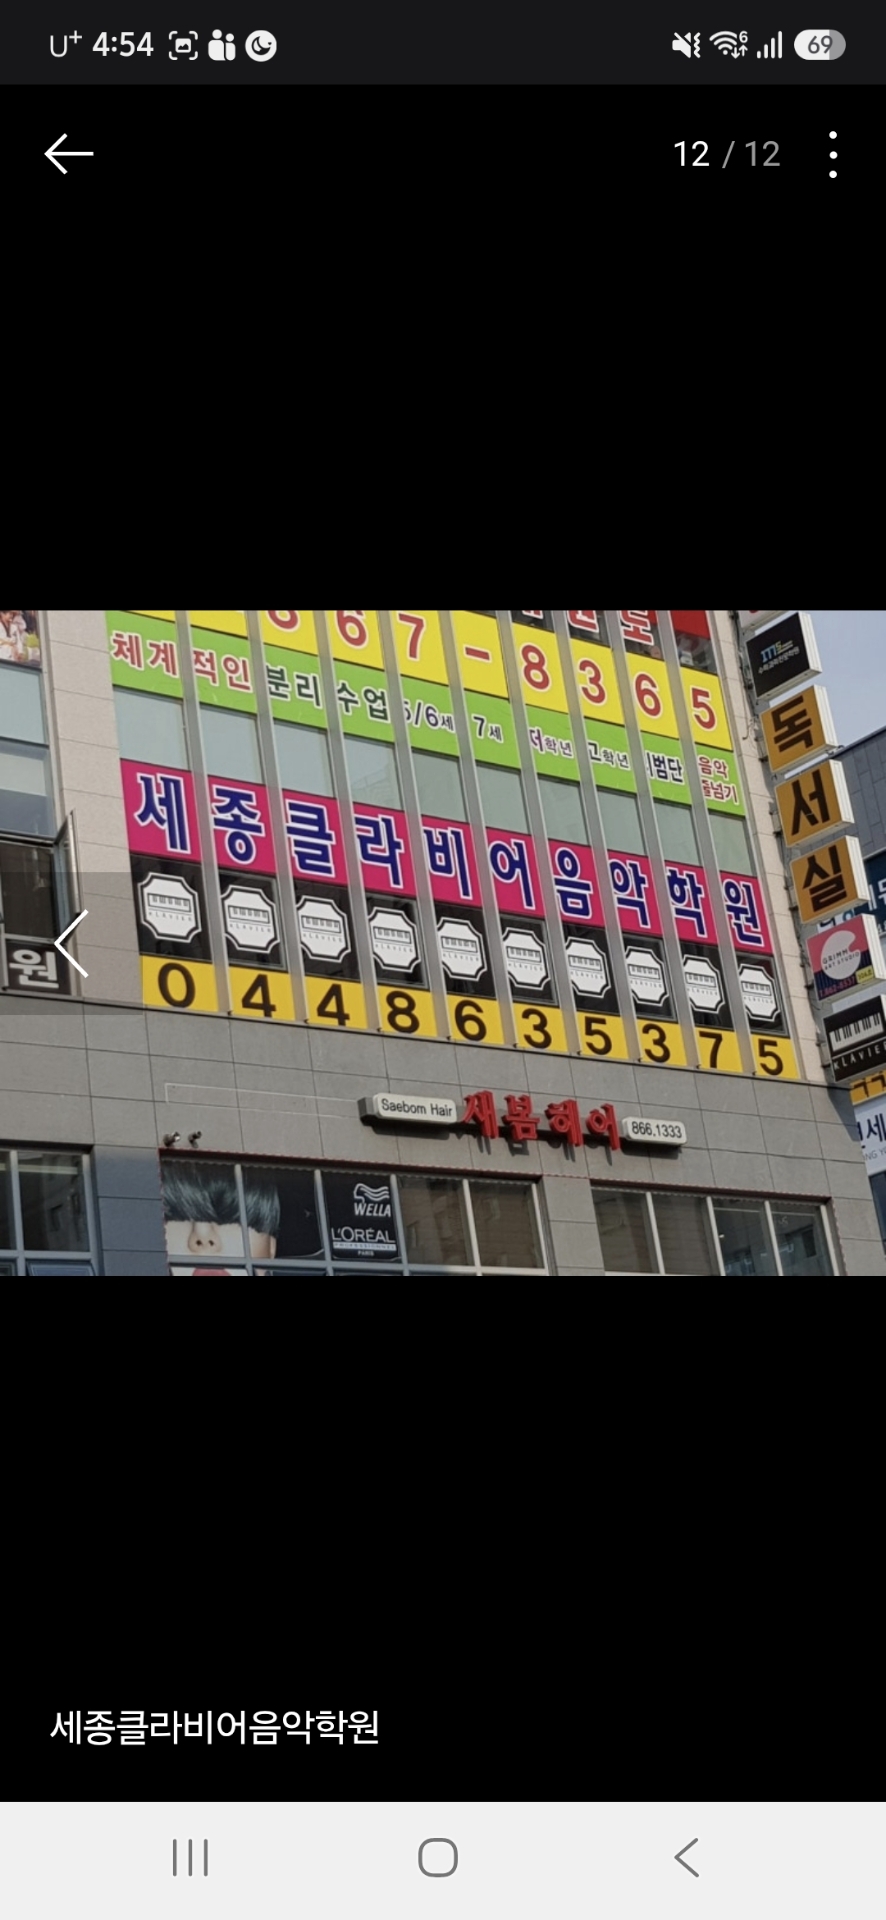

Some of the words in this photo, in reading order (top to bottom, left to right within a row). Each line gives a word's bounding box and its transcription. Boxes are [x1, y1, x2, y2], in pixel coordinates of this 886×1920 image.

[645, 752, 684, 783] 범단
[698, 755, 728, 779] 음악
[135, 773, 764, 947] 세종클라비어음악학원
[822, 948, 848, 964] GRIMM
[837, 951, 860, 965] STUDIO
[9, 949, 60, 989] 원
[381, 1098, 427, 1115] Saebom
[430, 1102, 453, 1117] Hair
[462, 1090, 622, 1150] 새봄헤어
[631, 1120, 682, 1139] 866.1333
[354, 1202, 391, 1217] WELLA
[331, 1226, 396, 1243] L'ORÉAL
